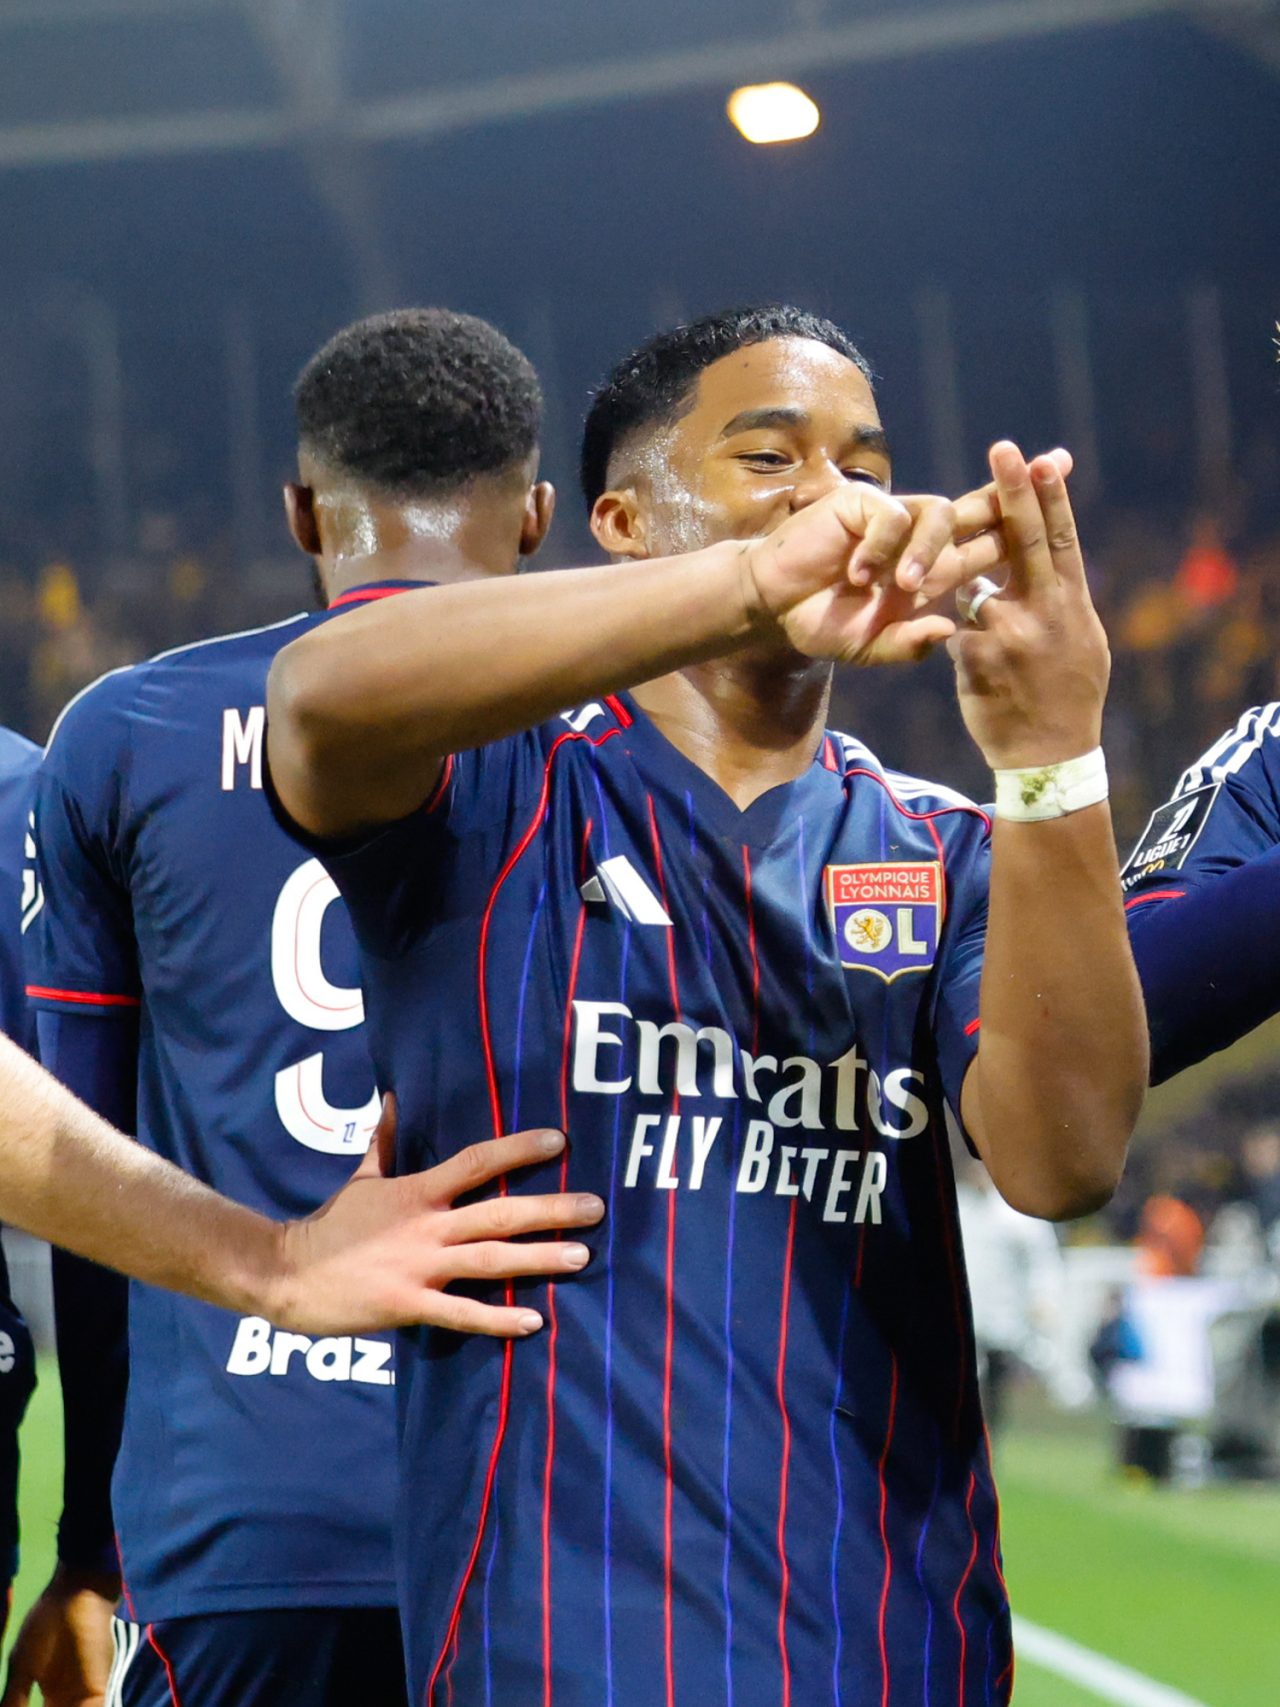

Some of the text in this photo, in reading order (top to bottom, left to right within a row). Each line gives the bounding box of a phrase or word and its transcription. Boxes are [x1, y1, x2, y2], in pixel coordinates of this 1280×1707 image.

[221, 705, 266, 791] M
[839, 871, 930, 885] OLYMPIQUE
[1133, 836, 1183, 868] LIGUE
[840, 884, 930, 900] LYONNAIS
[271, 856, 383, 1155] 9
[623, 1113, 723, 1191] FLY
[226, 1315, 396, 1386] Braz
